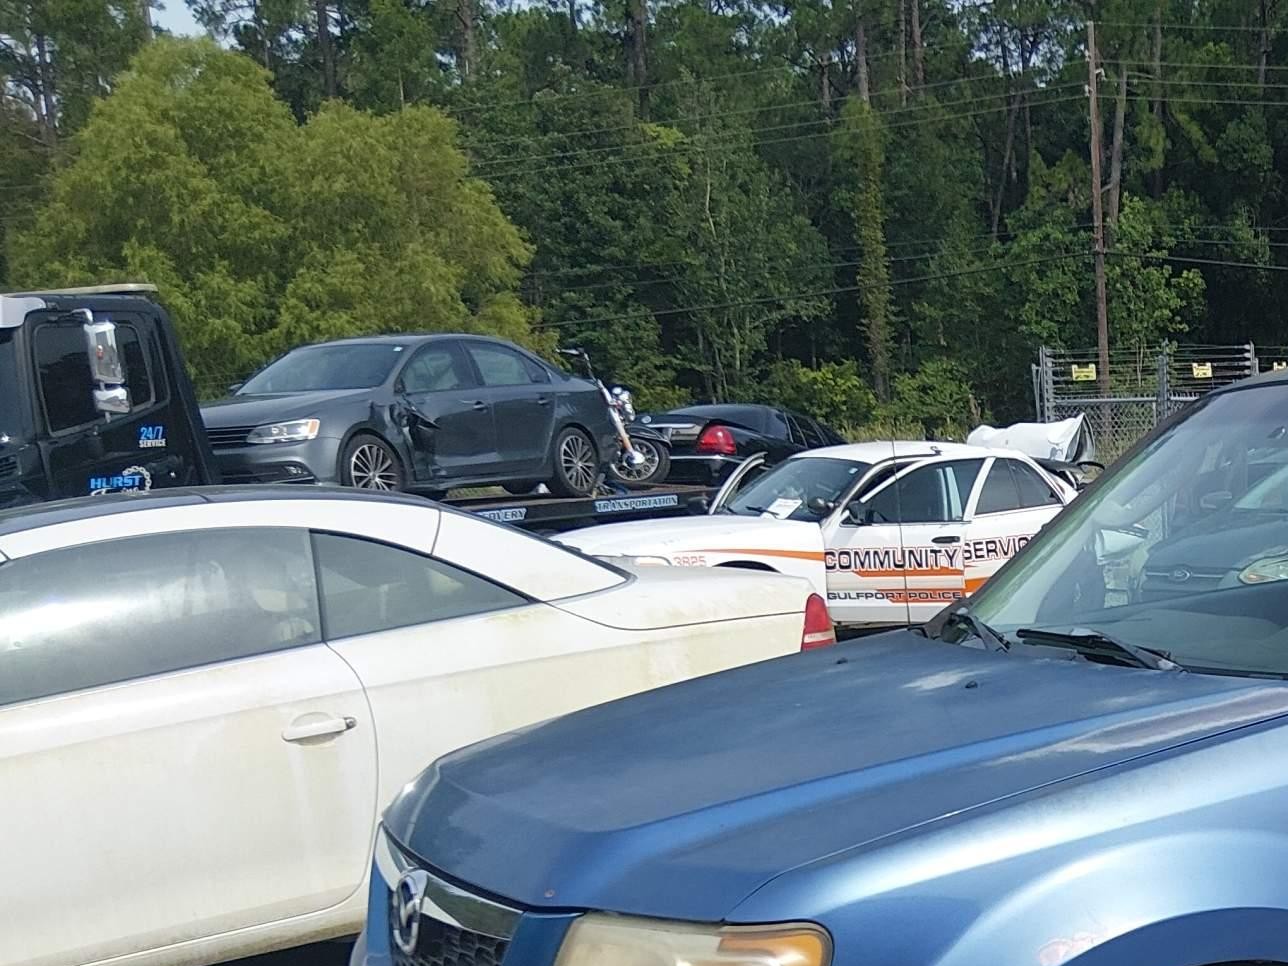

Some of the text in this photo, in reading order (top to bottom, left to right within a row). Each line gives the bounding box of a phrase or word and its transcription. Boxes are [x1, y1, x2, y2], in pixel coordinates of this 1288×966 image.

[140, 426, 163, 440] 24/7
[139, 439, 167, 448] SERVICE
[90, 476, 142, 489] HURST
[596, 497, 677, 511] TRANSPORTATION
[825, 547, 958, 571] COMMUNITY
[827, 592, 962, 601] GULFPORT POLICE
